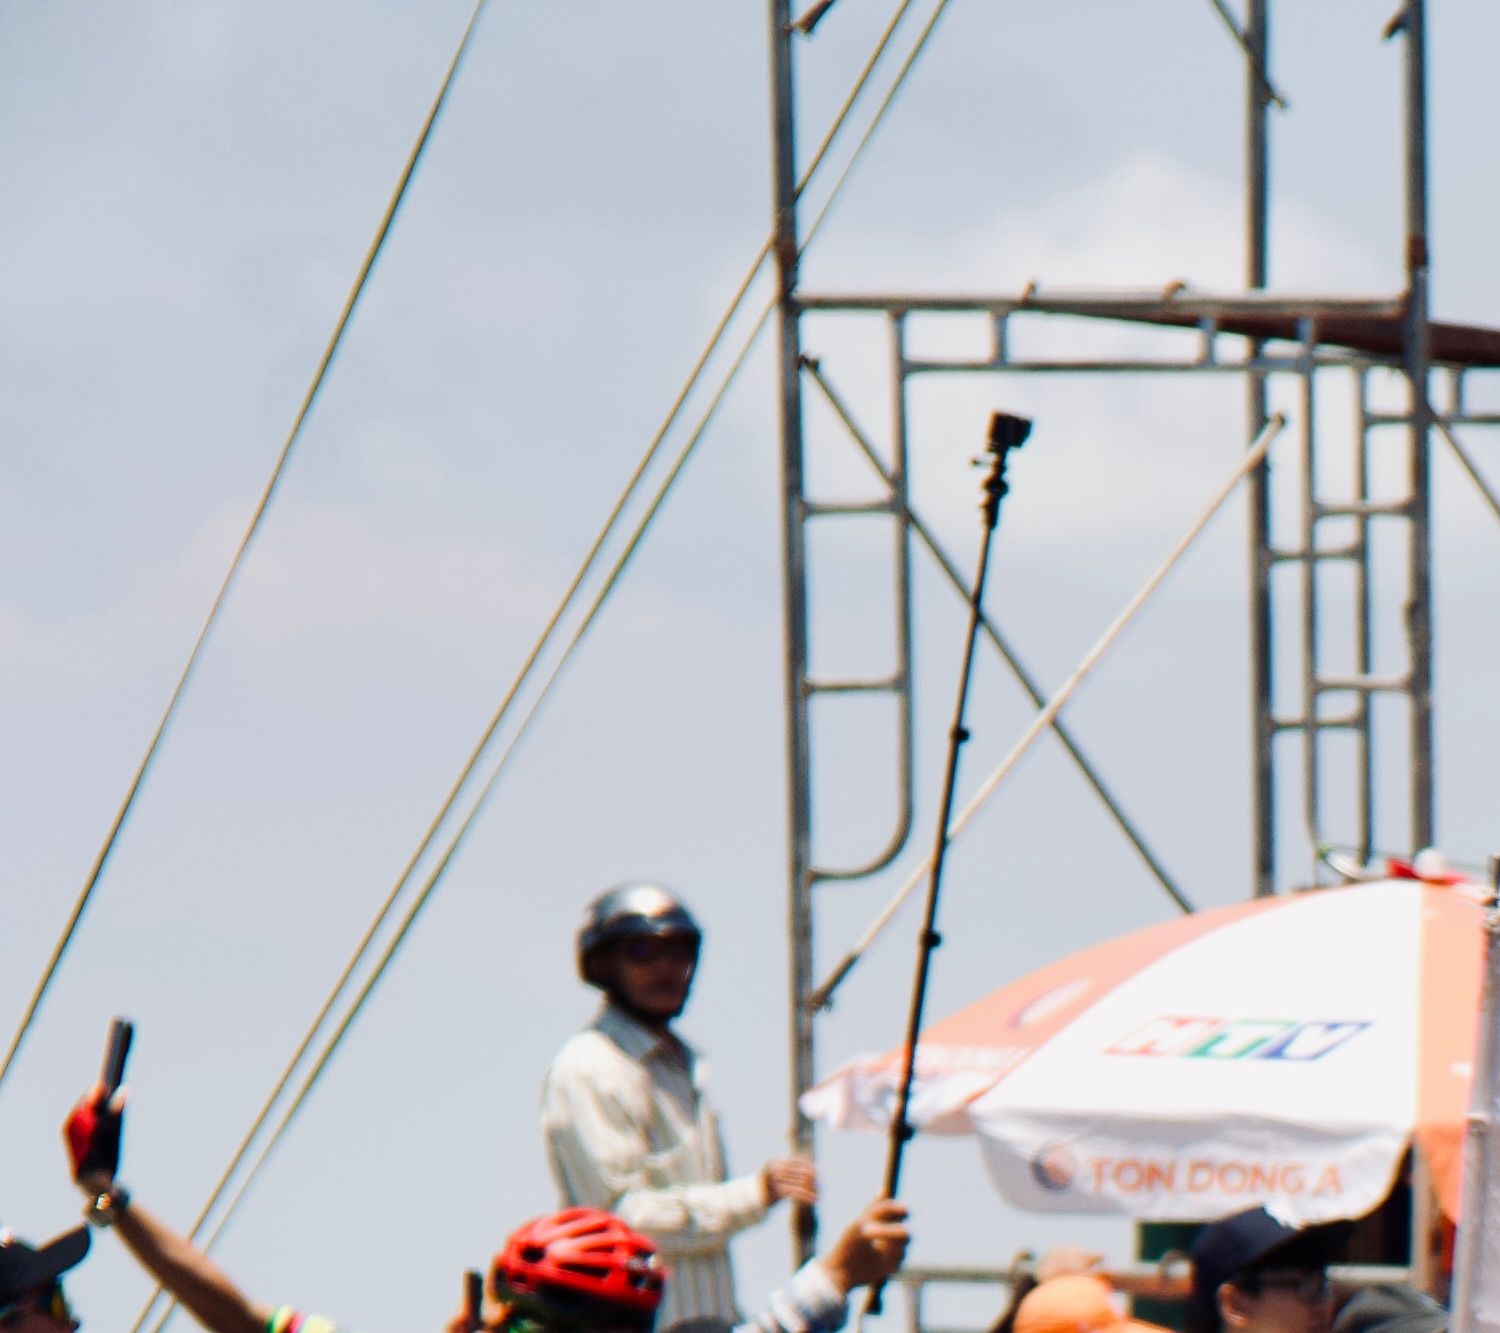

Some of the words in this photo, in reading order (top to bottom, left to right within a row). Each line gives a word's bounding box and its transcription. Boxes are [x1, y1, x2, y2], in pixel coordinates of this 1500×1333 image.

[1090, 1156, 1177, 1193] TON
[1186, 1158, 1305, 1194] DONG
[1311, 1162, 1344, 1196] A
